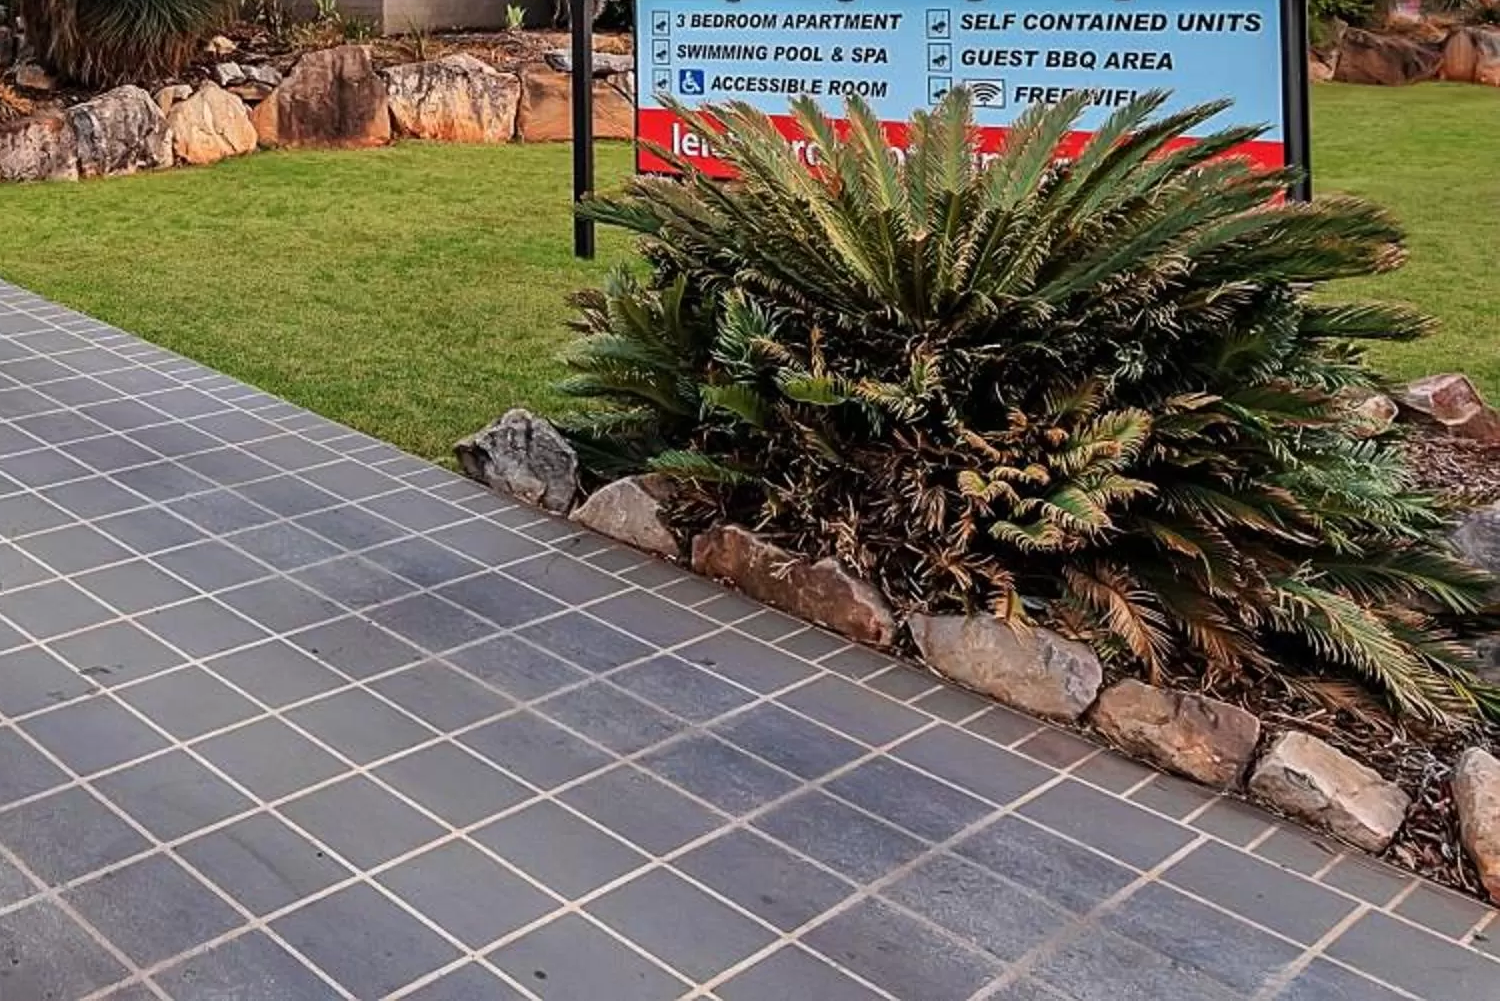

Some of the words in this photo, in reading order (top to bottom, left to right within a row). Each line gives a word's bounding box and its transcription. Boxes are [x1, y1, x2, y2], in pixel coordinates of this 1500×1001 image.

[676, 14, 686, 29] 3
[691, 13, 777, 30] BEDROOM
[782, 13, 903, 31] APARTMENT
[961, 13, 1017, 31] SELF
[1023, 13, 1168, 32] CONTAINED
[1177, 13, 1262, 32] UNITS
[676, 44, 768, 61] SWIMMING
[773, 46, 823, 63] POOL
[831, 46, 844, 63] &
[851, 47, 889, 64] SPA
[961, 49, 1038, 68] GUEST
[1045, 51, 1097, 71] BBQ
[1103, 52, 1174, 71] AREA
[711, 76, 823, 96] ACCESSIBLE
[828, 80, 888, 98] ROOM
